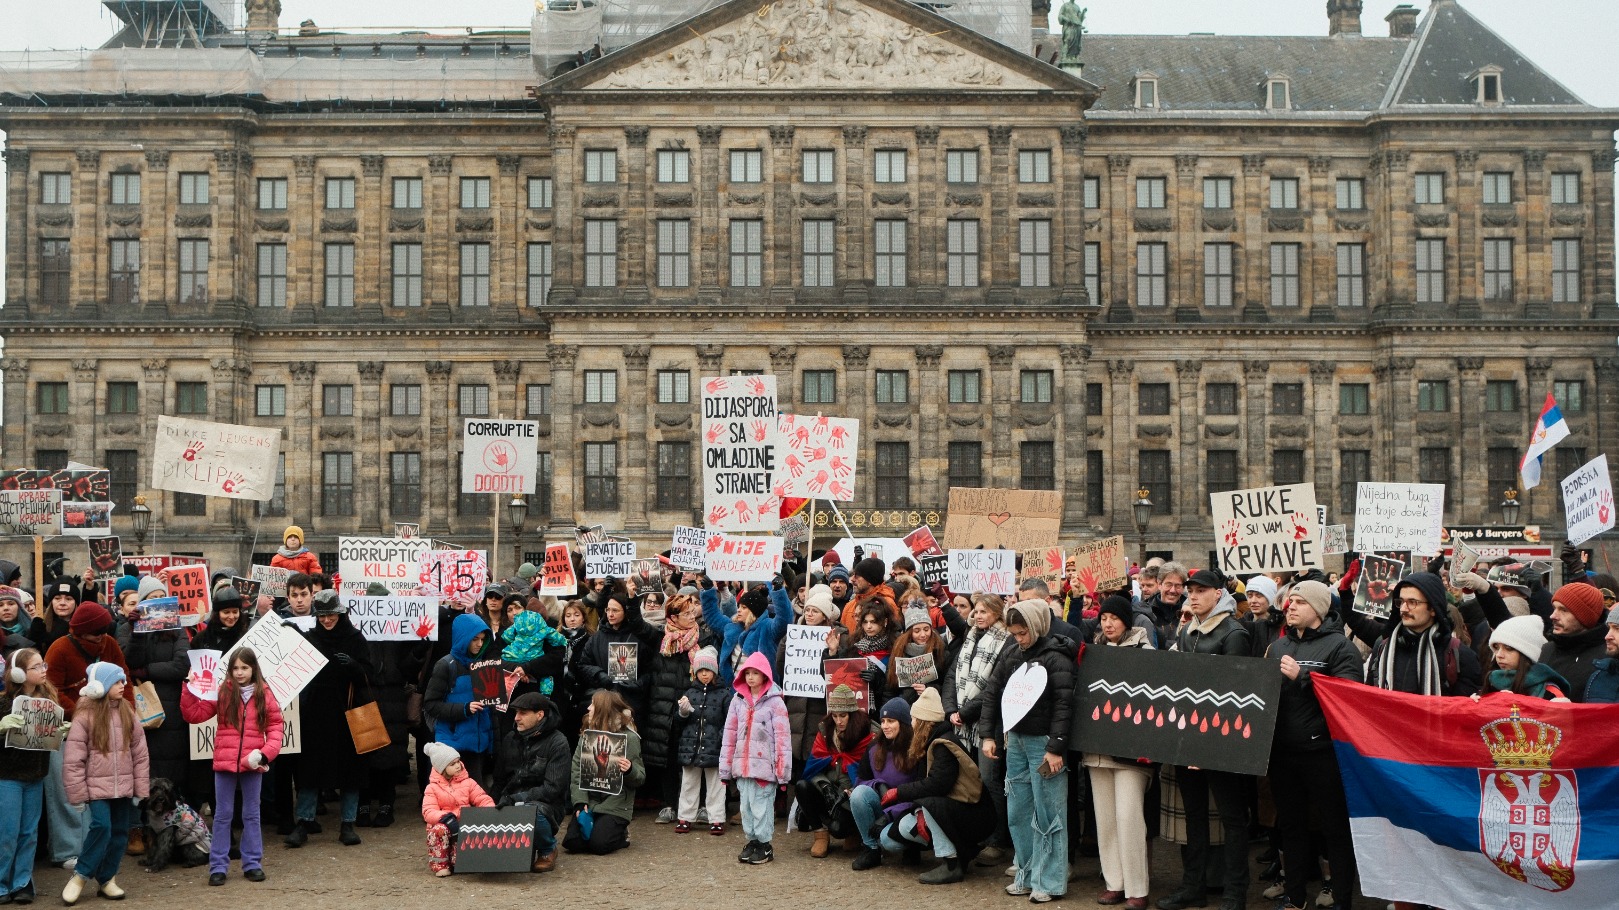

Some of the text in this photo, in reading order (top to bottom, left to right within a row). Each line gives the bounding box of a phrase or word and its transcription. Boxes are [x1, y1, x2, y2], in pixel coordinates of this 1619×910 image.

[705, 396, 775, 419] DIJASPORA
[468, 421, 535, 438] CORRUPTIE
[729, 422, 747, 444] SA
[219, 431, 271, 448] LEUGENS
[706, 444, 775, 471] OMLADINE
[474, 473, 524, 492] DOODT!
[715, 472, 772, 494] STRANE!
[18, 491, 52, 504] КРВАВЕ
[1231, 488, 1295, 519] RUKE
[1358, 485, 1430, 508] Nijedna tuga
[19, 513, 53, 525] КРВАВЕ
[1357, 506, 1371, 516] ne
[1374, 504, 1397, 519] traje
[1245, 520, 1284, 536] SU VAM
[1359, 522, 1395, 534] važno
[1408, 527, 1428, 537] sine
[1450, 529, 1523, 540] Dogs & Burgers
[586, 543, 635, 556] HRVATICE
[1355, 536, 1368, 551] da
[121, 557, 163, 567] OTDOGS
[545, 549, 567, 563] 61%
[957, 552, 983, 570] RUKE
[987, 552, 1003, 571] SU
[1222, 540, 1316, 572] KRVAVE
[364, 563, 407, 578] KILLS
[430, 559, 475, 593] 15
[545, 563, 570, 575] PLUS
[170, 572, 203, 588] 61%
[546, 576, 563, 585] MI.
[949, 572, 970, 591] VAM
[970, 571, 1011, 593] KRVAVE
[349, 599, 427, 618] RUKE SU VAM
[359, 619, 410, 636] KRVAVE
[264, 640, 327, 699] DENTE
